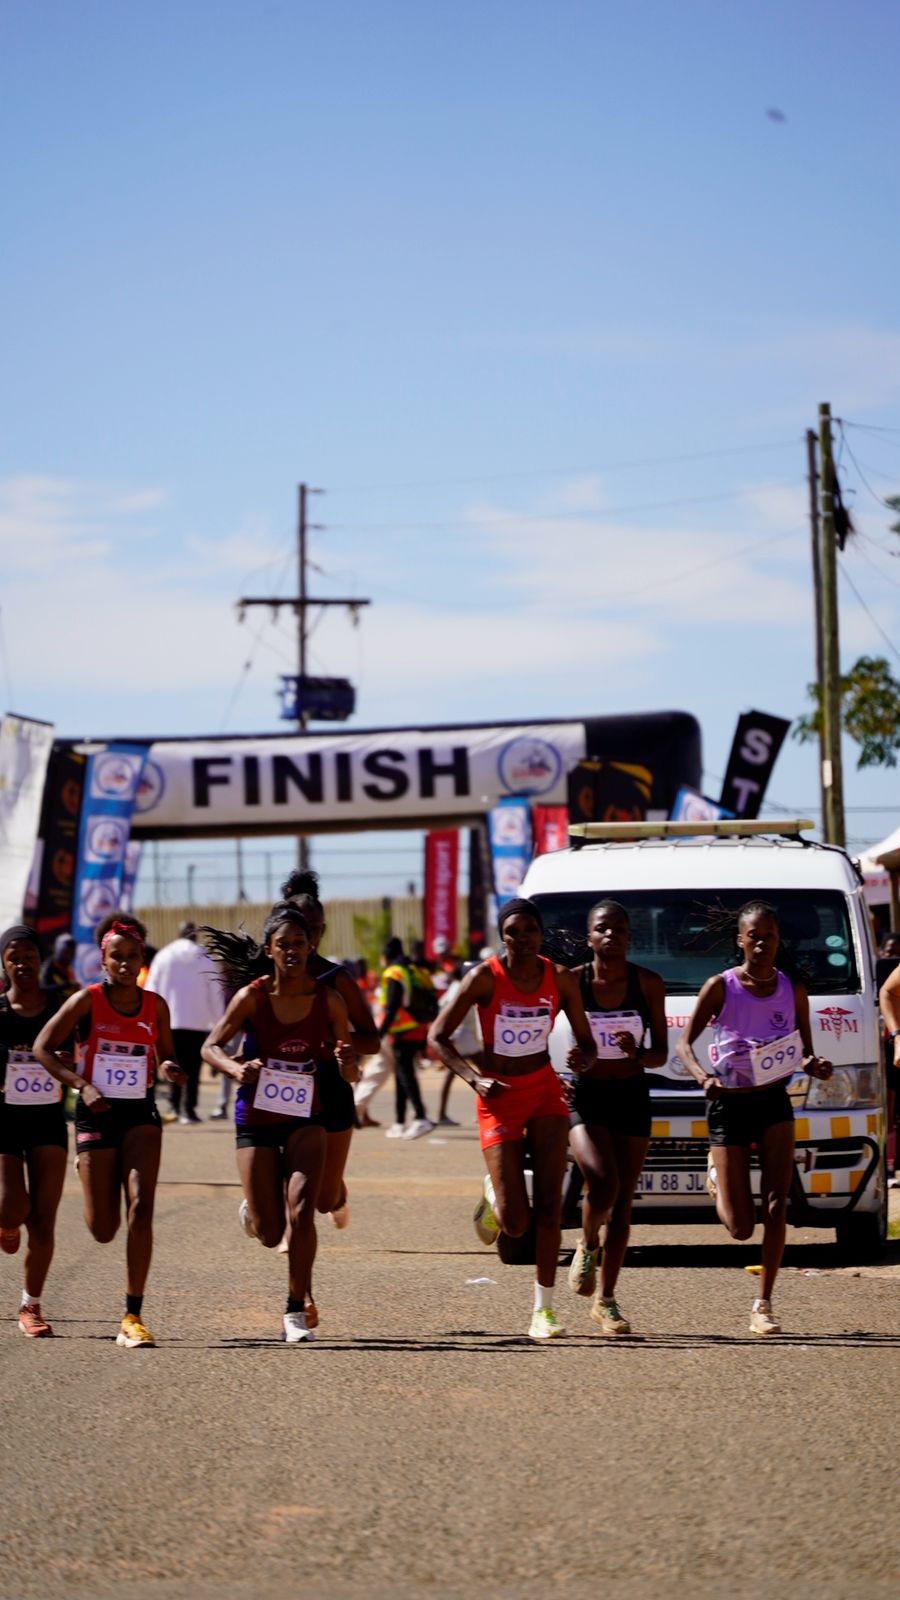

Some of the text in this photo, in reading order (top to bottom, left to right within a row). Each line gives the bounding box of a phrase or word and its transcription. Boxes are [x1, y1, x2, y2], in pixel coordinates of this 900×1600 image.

[192, 748, 469, 808] FINISH
[501, 1028, 543, 1045] 007
[760, 1045, 796, 1071] 099
[14, 1077, 54, 1093] 066
[105, 1069, 138, 1086] 193
[264, 1083, 307, 1104] 008
[660, 1173, 679, 1191] 88
[686, 1173, 704, 1191] JL
